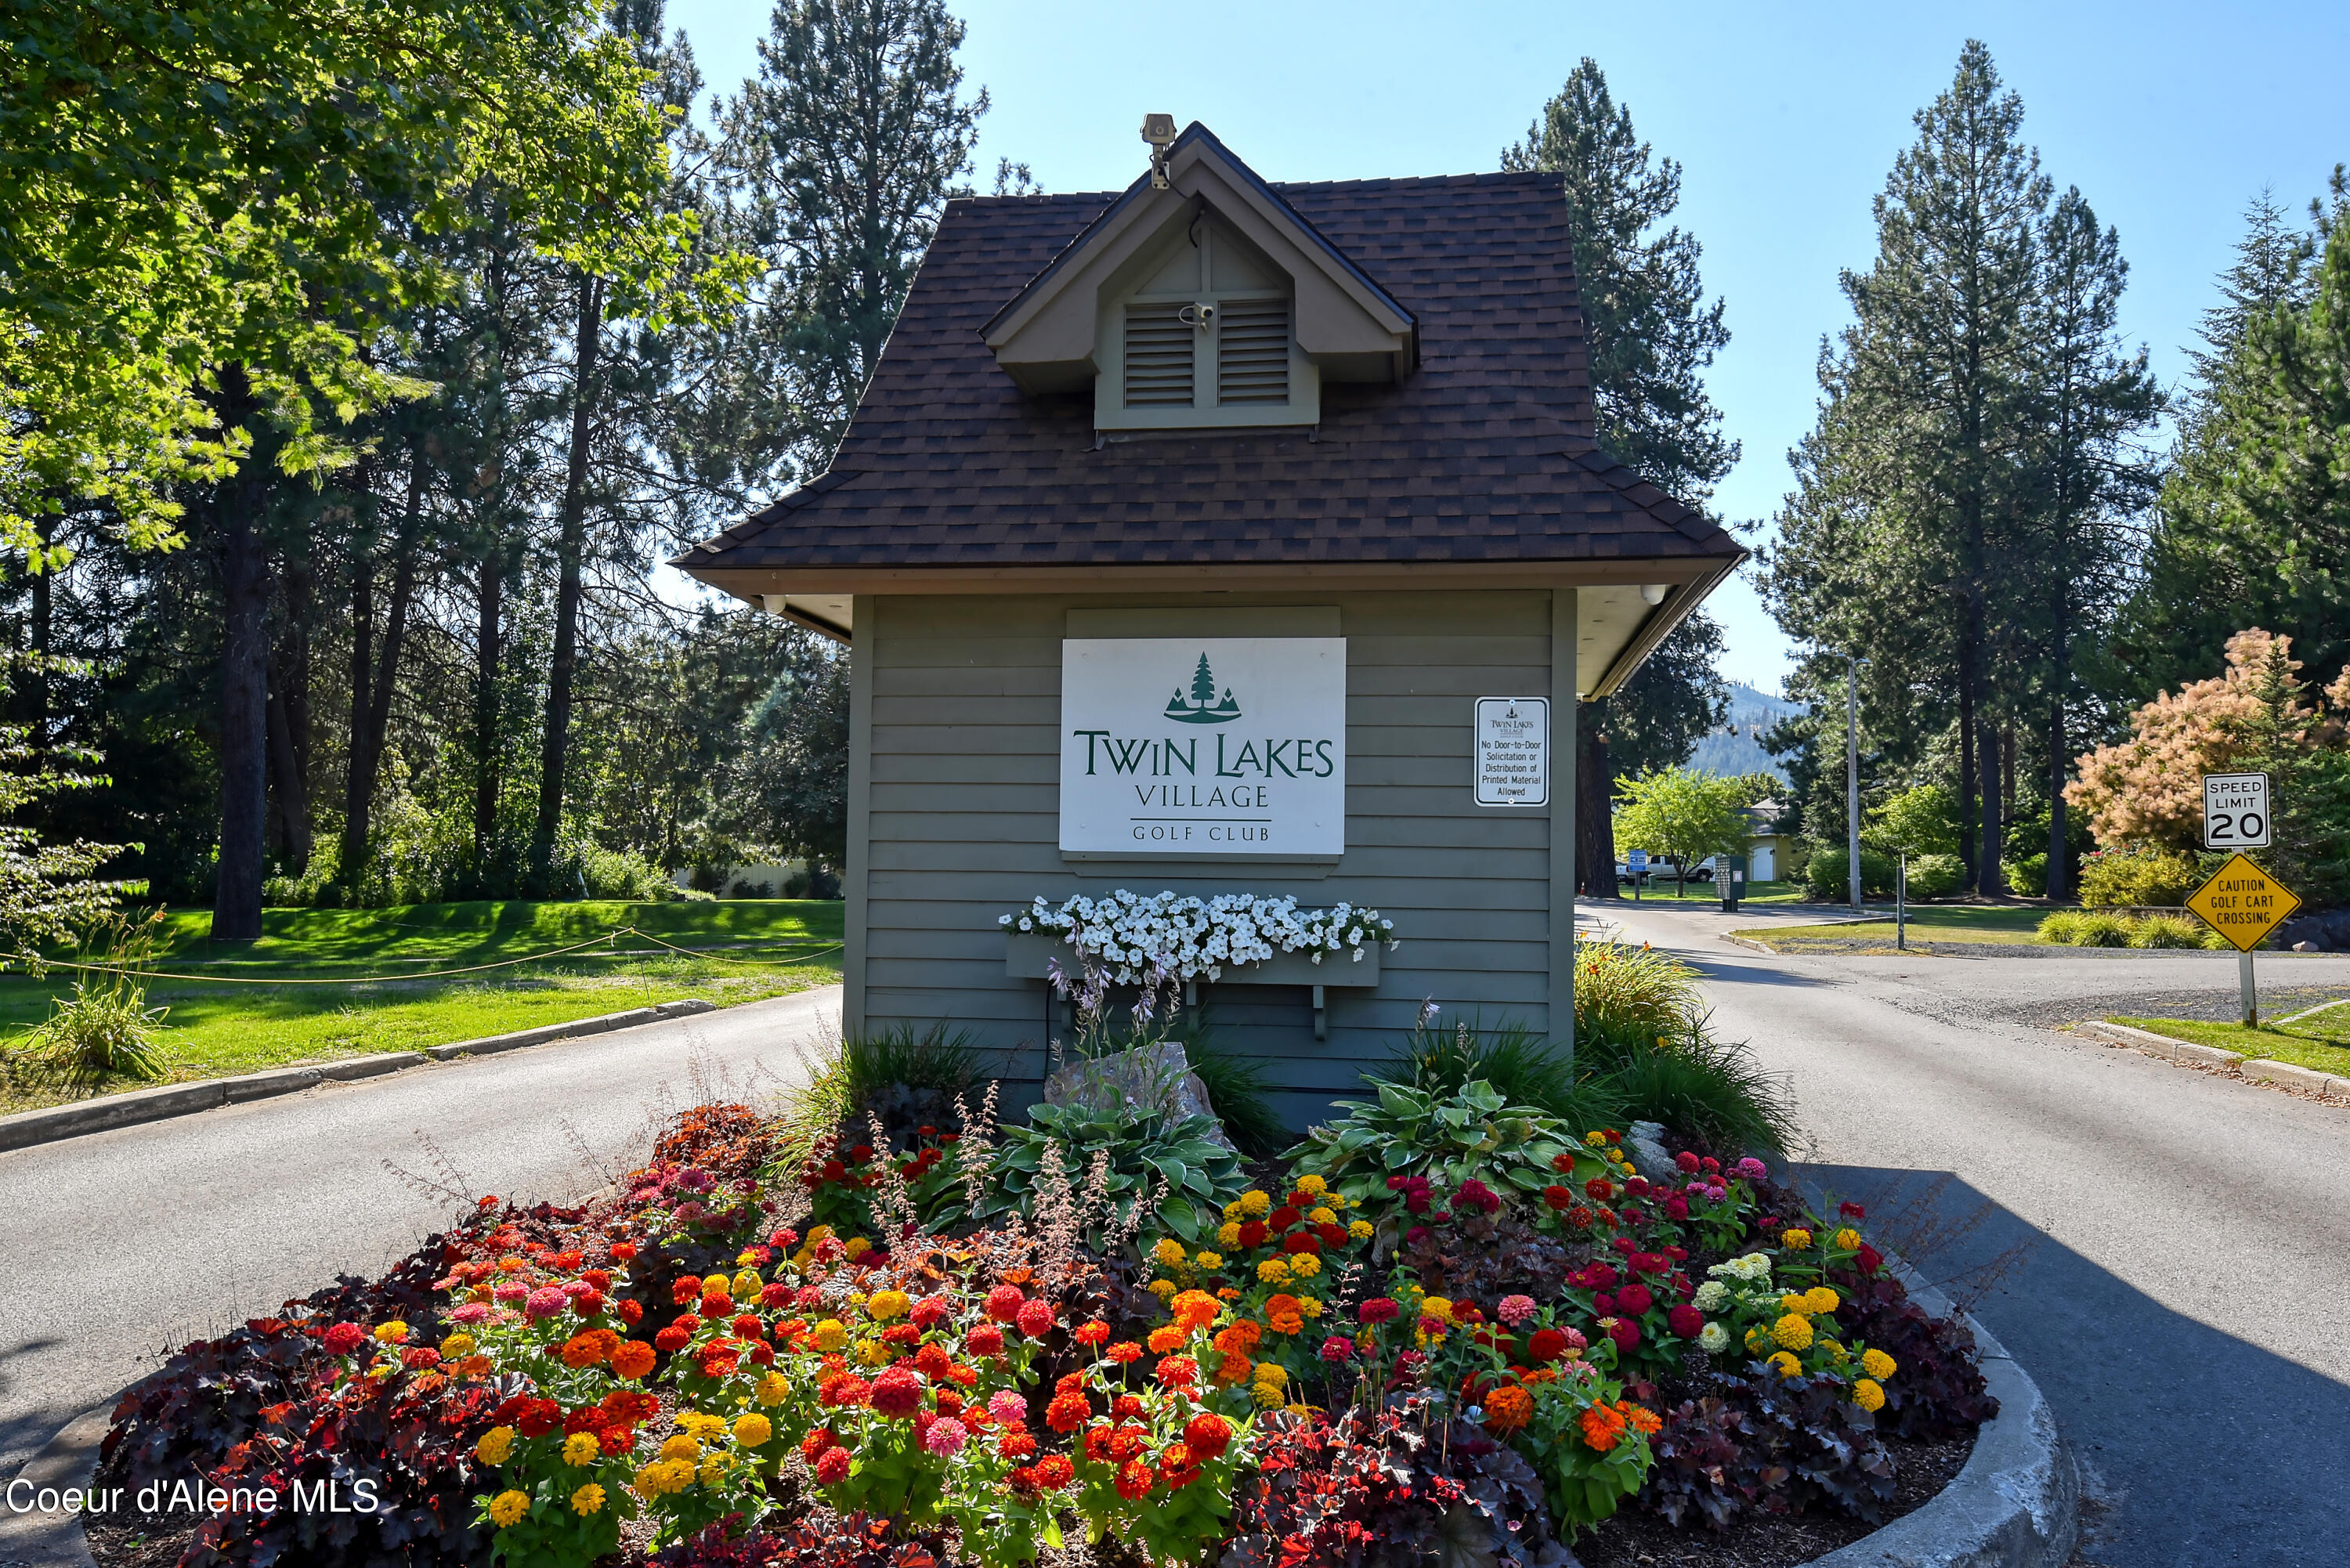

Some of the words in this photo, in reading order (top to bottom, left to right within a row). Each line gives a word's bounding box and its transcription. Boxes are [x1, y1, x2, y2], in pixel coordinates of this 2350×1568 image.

[1481, 740, 1491, 750] No
[1494, 740, 1542, 750] Door-to-Door
[1072, 730, 1198, 776] TWIN
[1214, 733, 1334, 779] LAKES
[1486, 751, 1527, 761] Solicitation
[1485, 763, 1527, 773] Distribution
[1530, 764, 1537, 773] of
[1482, 775, 1508, 784] Printed
[1511, 775, 1541, 785] Material
[1497, 786, 1526, 797] Allowed
[2209, 782, 2261, 794] SPEED
[1134, 785, 1268, 807] VILLAGE
[2215, 797, 2256, 809] LIMIT
[2210, 812, 2264, 840] 20
[1133, 826, 1191, 840] GOLF
[1209, 826, 1269, 841] CLUB
[2218, 879, 2265, 892] CAUTION
[2211, 896, 2238, 909] GOLF
[2245, 895, 2274, 908] CART
[2216, 912, 2272, 925] CROSSING
